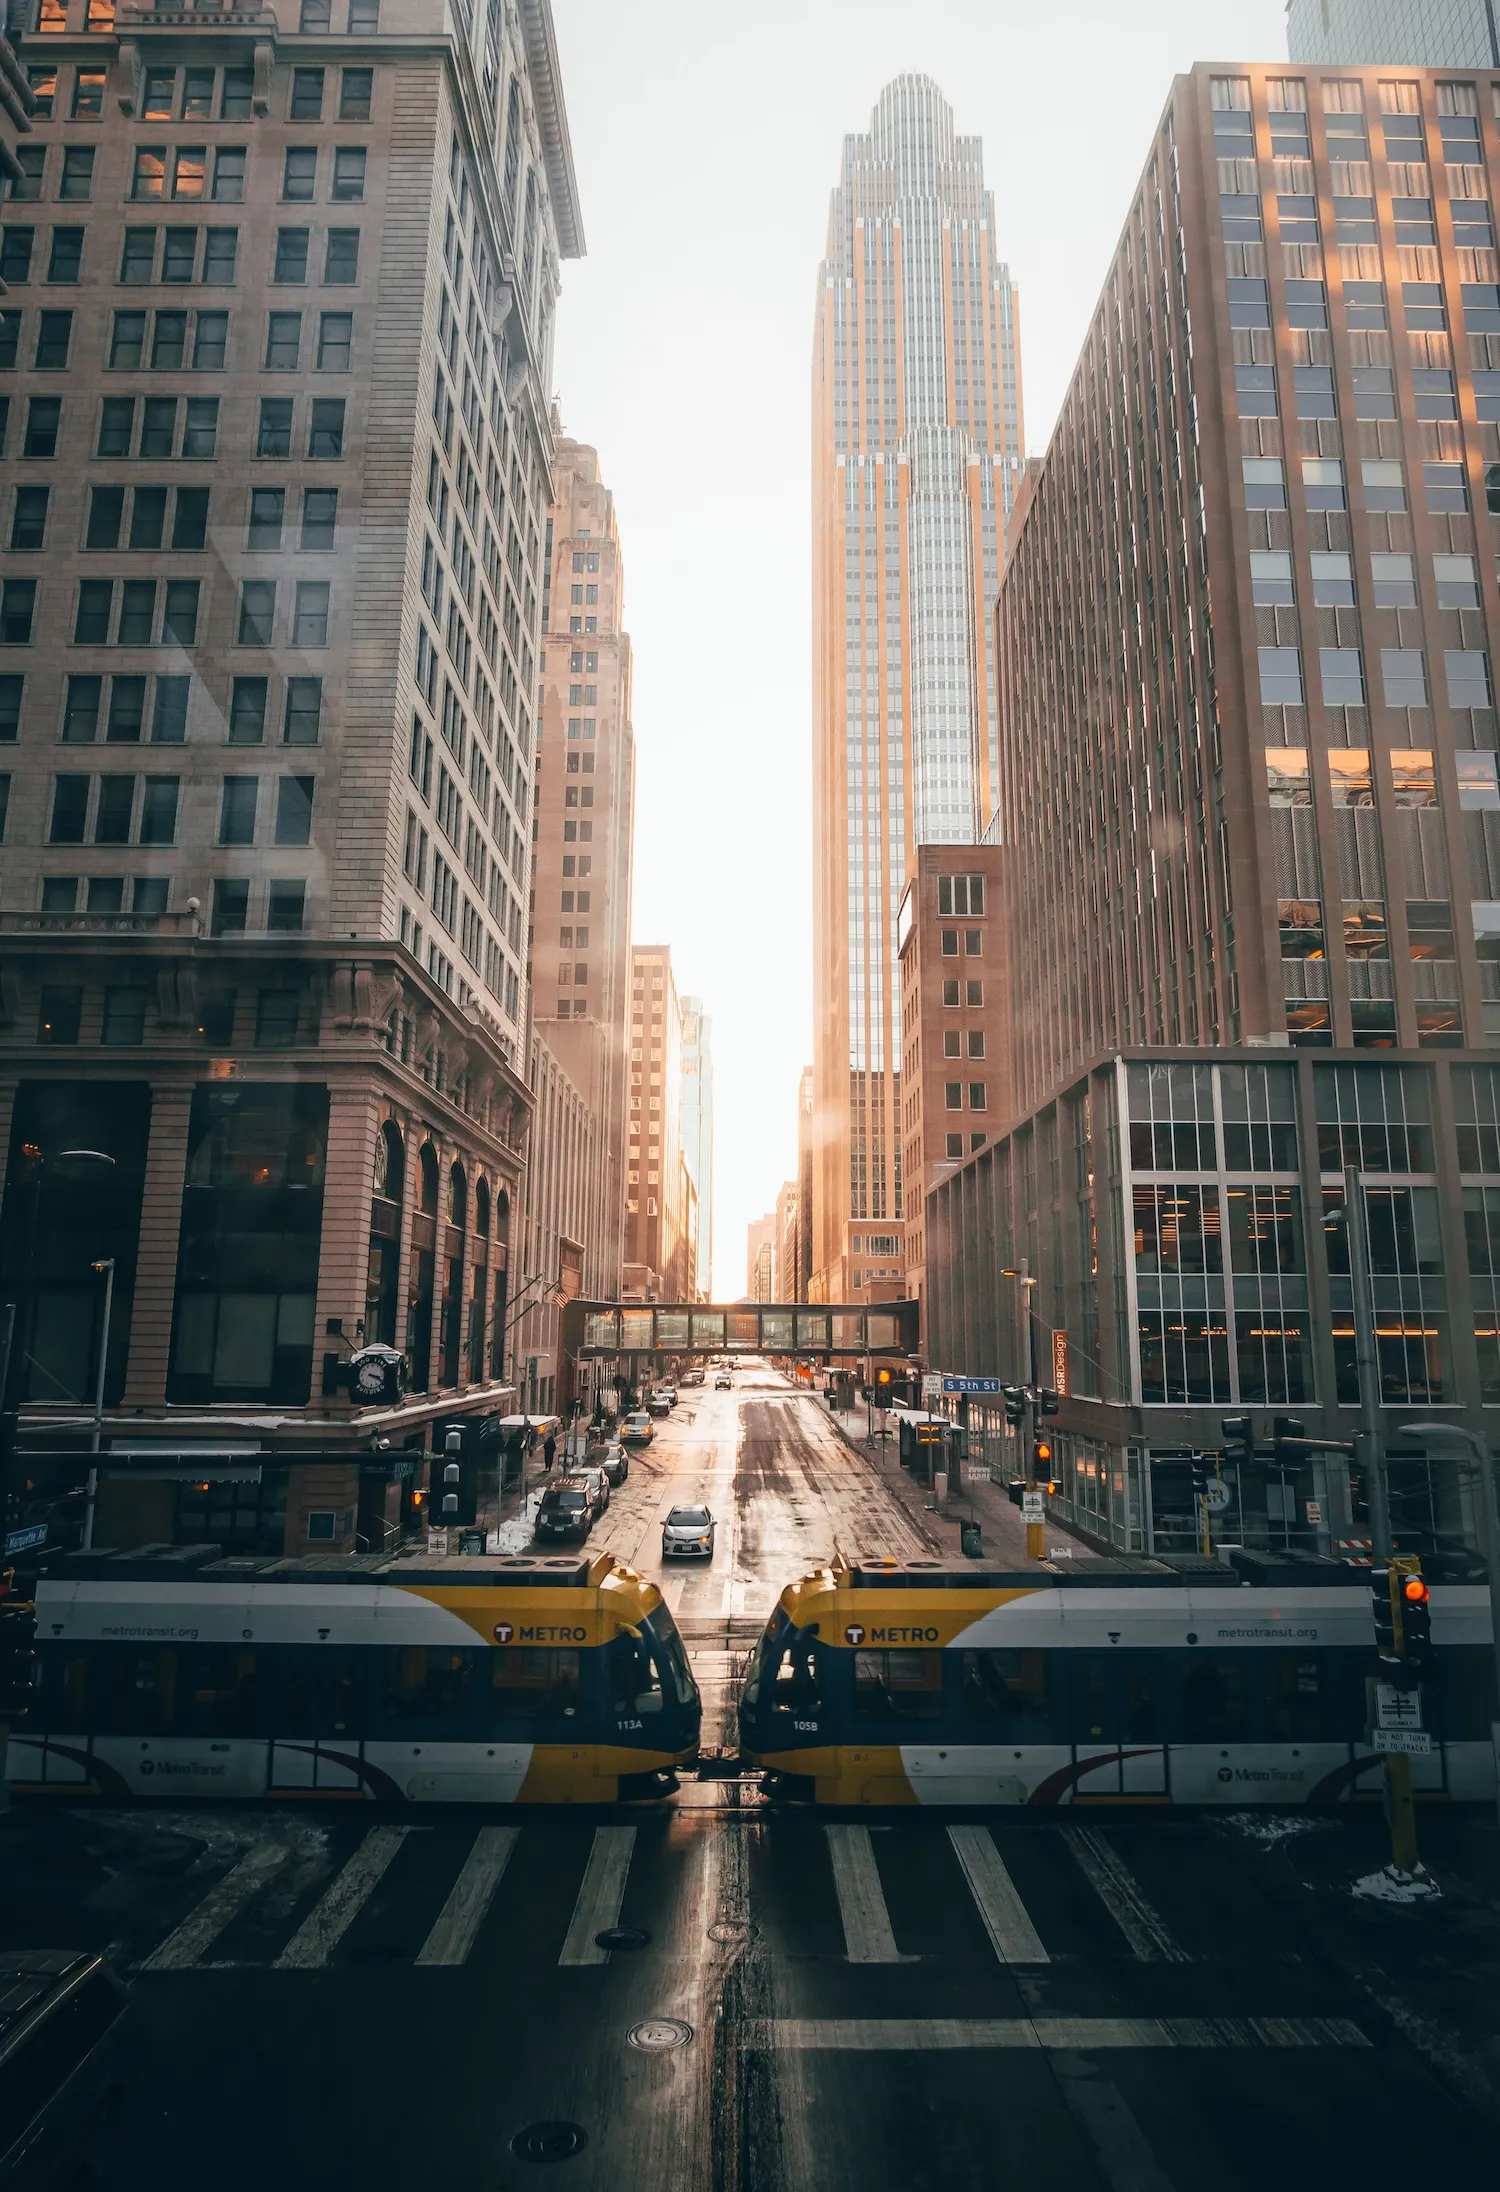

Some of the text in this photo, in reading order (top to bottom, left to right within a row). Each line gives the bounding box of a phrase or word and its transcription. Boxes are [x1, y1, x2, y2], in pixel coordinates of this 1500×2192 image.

[355, 1383, 385, 1395] BUILDING
[947, 1381, 996, 1390] S 5th St
[8, 1531, 36, 1549] Marquette
[101, 1626, 199, 1640] metrotransit.org
[519, 1626, 587, 1641] METRO
[871, 1627, 939, 1642] METRO
[1217, 1627, 1318, 1640] metrotransit.org
[617, 1719, 643, 1730] 113A
[794, 1720, 819, 1732] 105B
[1378, 1732, 1426, 1743] DO NOT TURN
[1390, 1743, 1399, 1751] TO
[1402, 1743, 1429, 1753] TRACKS
